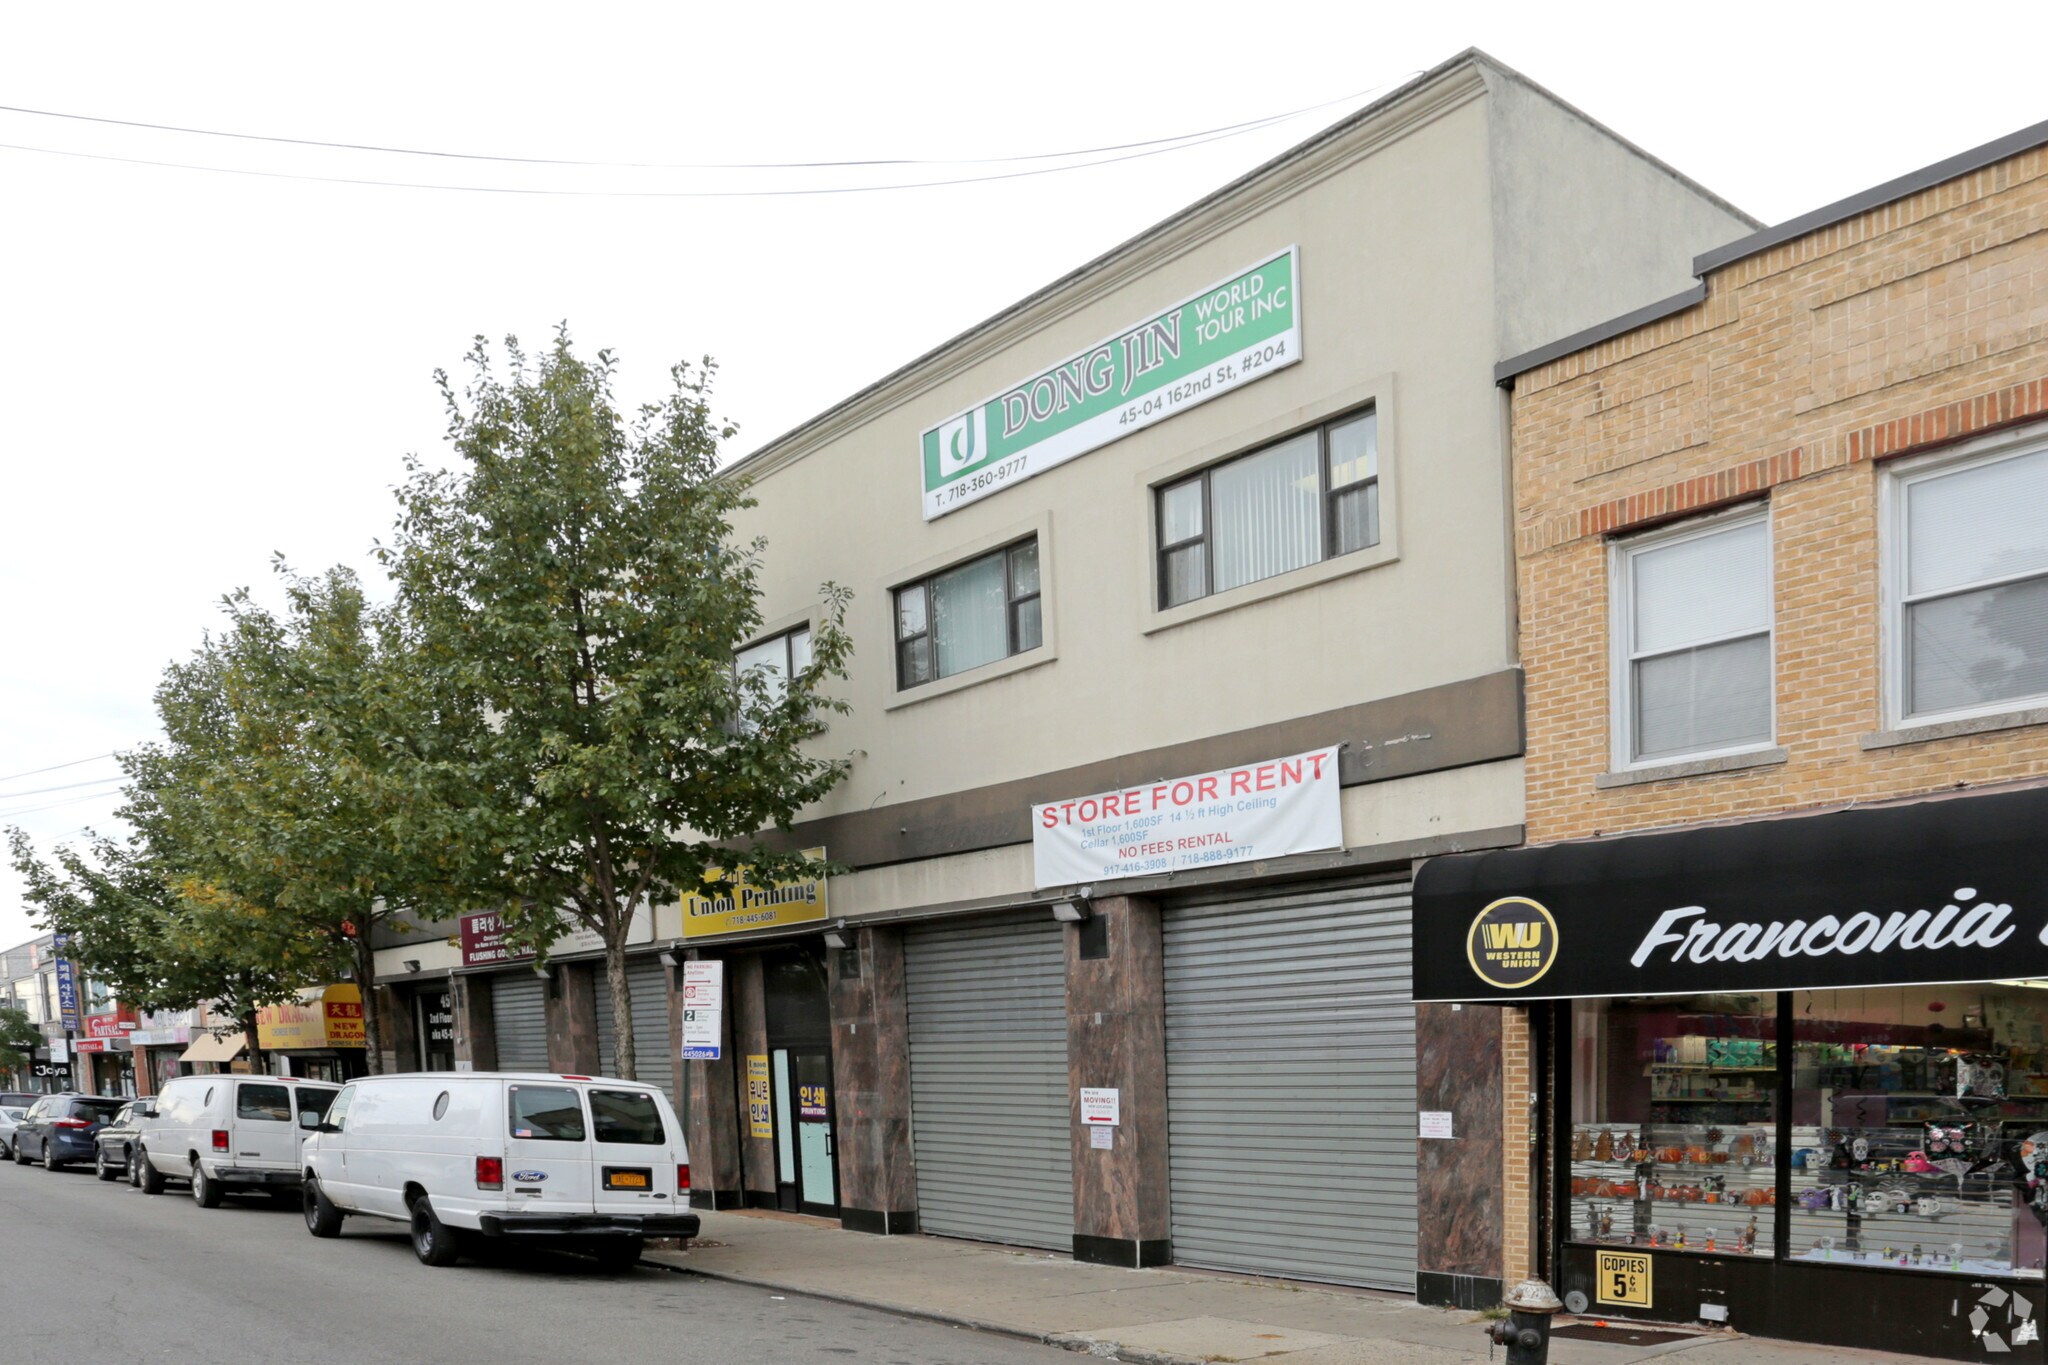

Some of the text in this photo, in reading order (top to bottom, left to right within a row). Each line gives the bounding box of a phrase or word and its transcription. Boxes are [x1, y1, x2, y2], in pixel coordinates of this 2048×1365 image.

[1195, 275, 1263, 321] WORLD
[1195, 286, 1287, 345] TOUR INC
[1002, 309, 1181, 439] DONG JIN
[1119, 340, 1286, 426] 45-04 162nd St, #204
[935, 455, 1028, 507] T. 718-360-9777
[1042, 753, 1328, 829] STORE FOR RENT
[1081, 827, 1096, 838] 1st
[1097, 824, 1122, 836] Floor
[1125, 814, 1164, 832] 1,600SF
[1170, 812, 1182, 823] 14
[1198, 807, 1206, 819] ft
[1208, 803, 1234, 818] High
[1237, 797, 1278, 813] Ceiling
[1081, 830, 1149, 850] Cellar 1,600SF
[1119, 832, 1233, 859] NO FEES RENTAL
[1103, 857, 1167, 875] 917-416-3908
[1181, 845, 1254, 865] 718-888-9177
[689, 881, 817, 917] Union Printing
[471, 915, 495, 934] 플러싱
[732, 911, 777, 926] 718-445-6081
[1630, 887, 2017, 968] Franconia
[1482, 922, 1542, 949] WU
[469, 949, 496, 962] FLUSHING
[1486, 951, 1540, 960] WESTERN
[1502, 959, 1540, 968] UNION
[334, 1022, 359, 1030] NEW
[686, 1011, 693, 1021] 2
[329, 1031, 367, 1039] DRAGON
[750, 1081, 768, 1100] 유니온
[800, 1086, 826, 1106] 인쇄
[751, 1104, 770, 1123] 인쇄
[801, 1107, 826, 1115] PRINTING
[517, 1171, 540, 1181] Ford
[1603, 1257, 1645, 1274] COPIES
